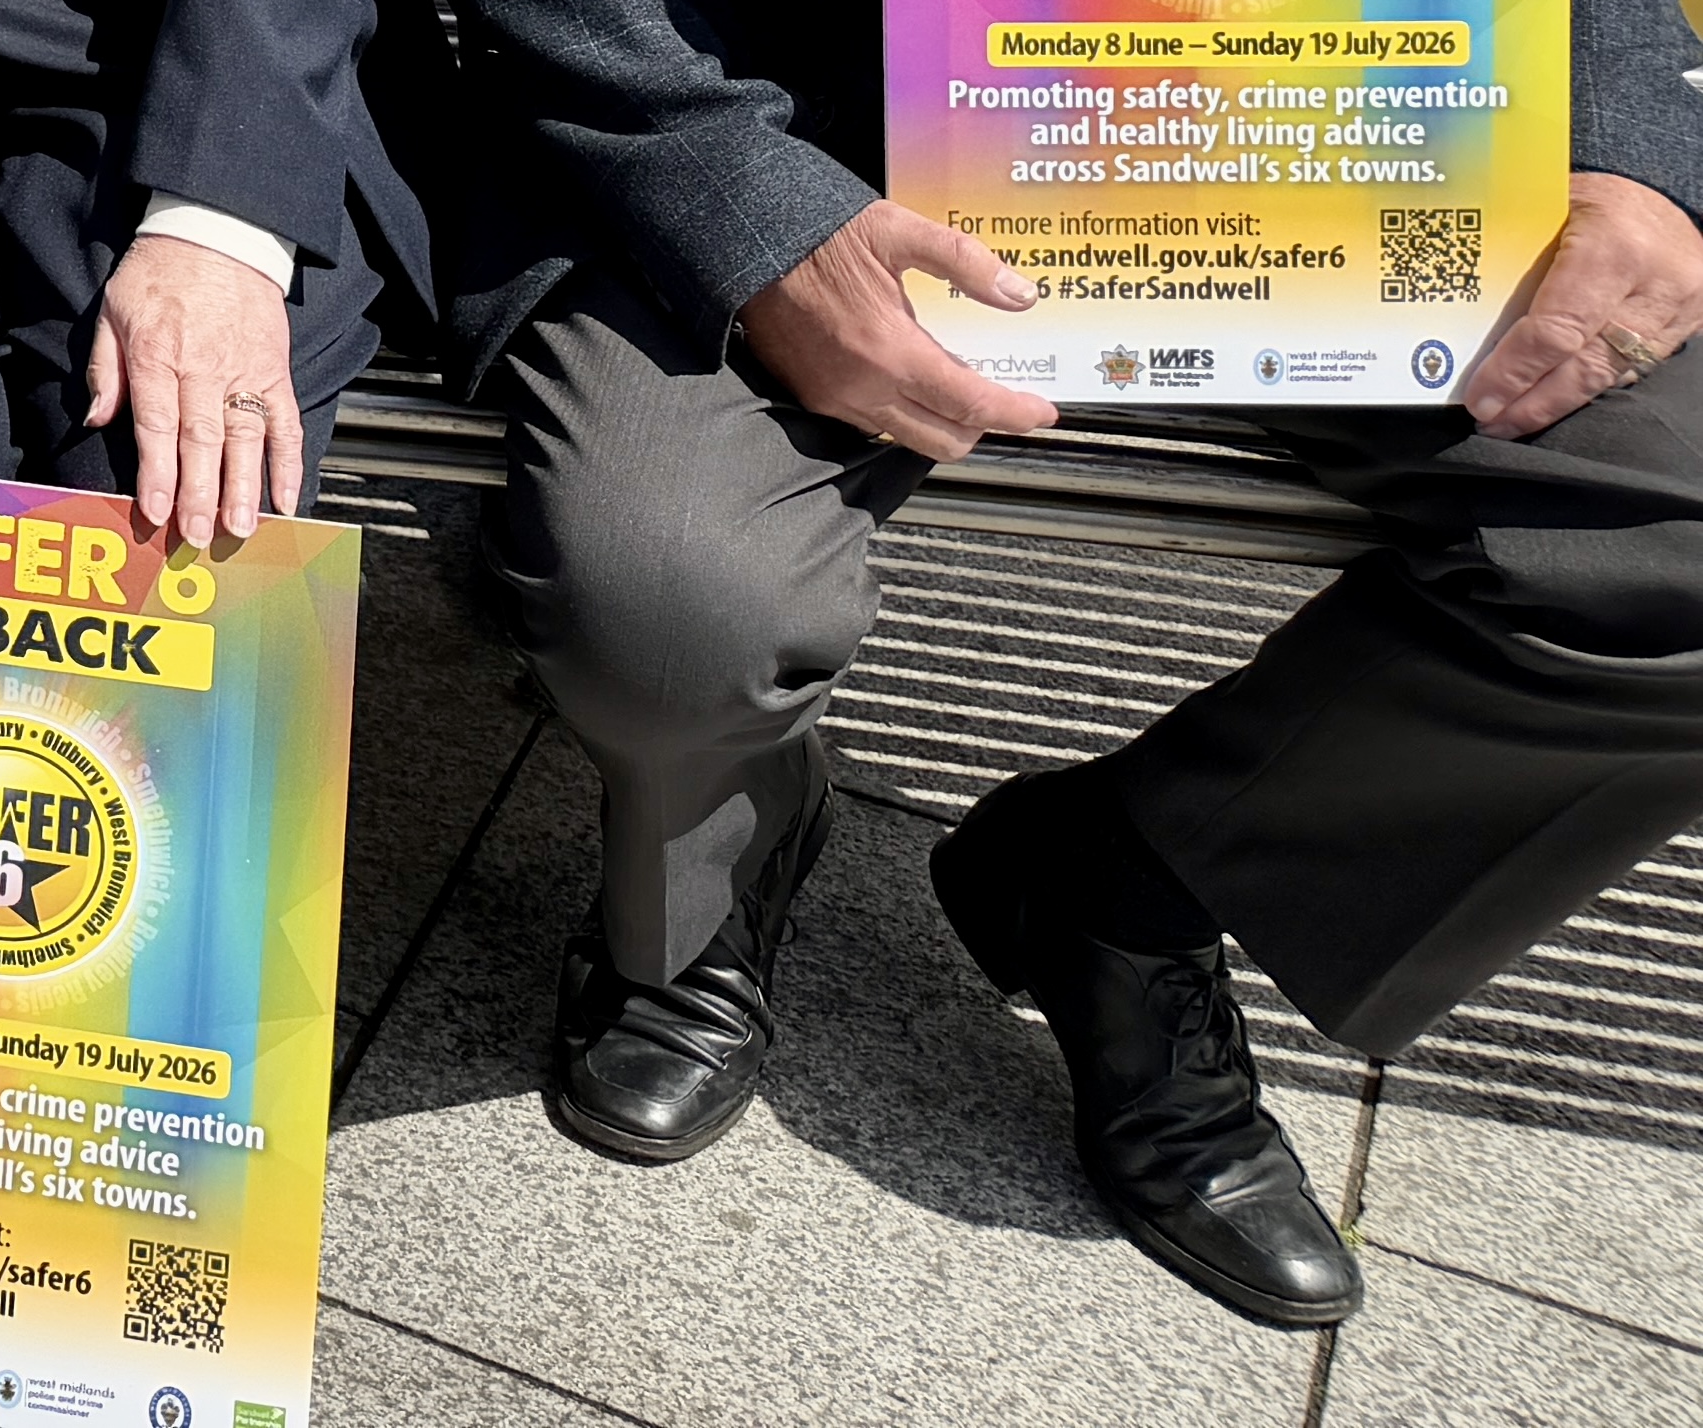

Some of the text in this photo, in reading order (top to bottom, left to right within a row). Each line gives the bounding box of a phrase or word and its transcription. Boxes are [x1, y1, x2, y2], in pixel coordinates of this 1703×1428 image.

[1001, 31, 1101, 62] Monday
[1105, 32, 1121, 56] 8
[1124, 31, 1184, 56] June
[1212, 30, 1304, 62] Sunday
[1309, 32, 1338, 56] 19
[1341, 30, 1392, 61] July
[1395, 31, 1456, 55] 2026
[948, 210, 1261, 236] For more information visit:
[997, 242, 1346, 272] w.sandwell.gov.uk/safer6
[1057, 275, 1270, 301] #SaferSandwell
[157, 540, 217, 616] 6
